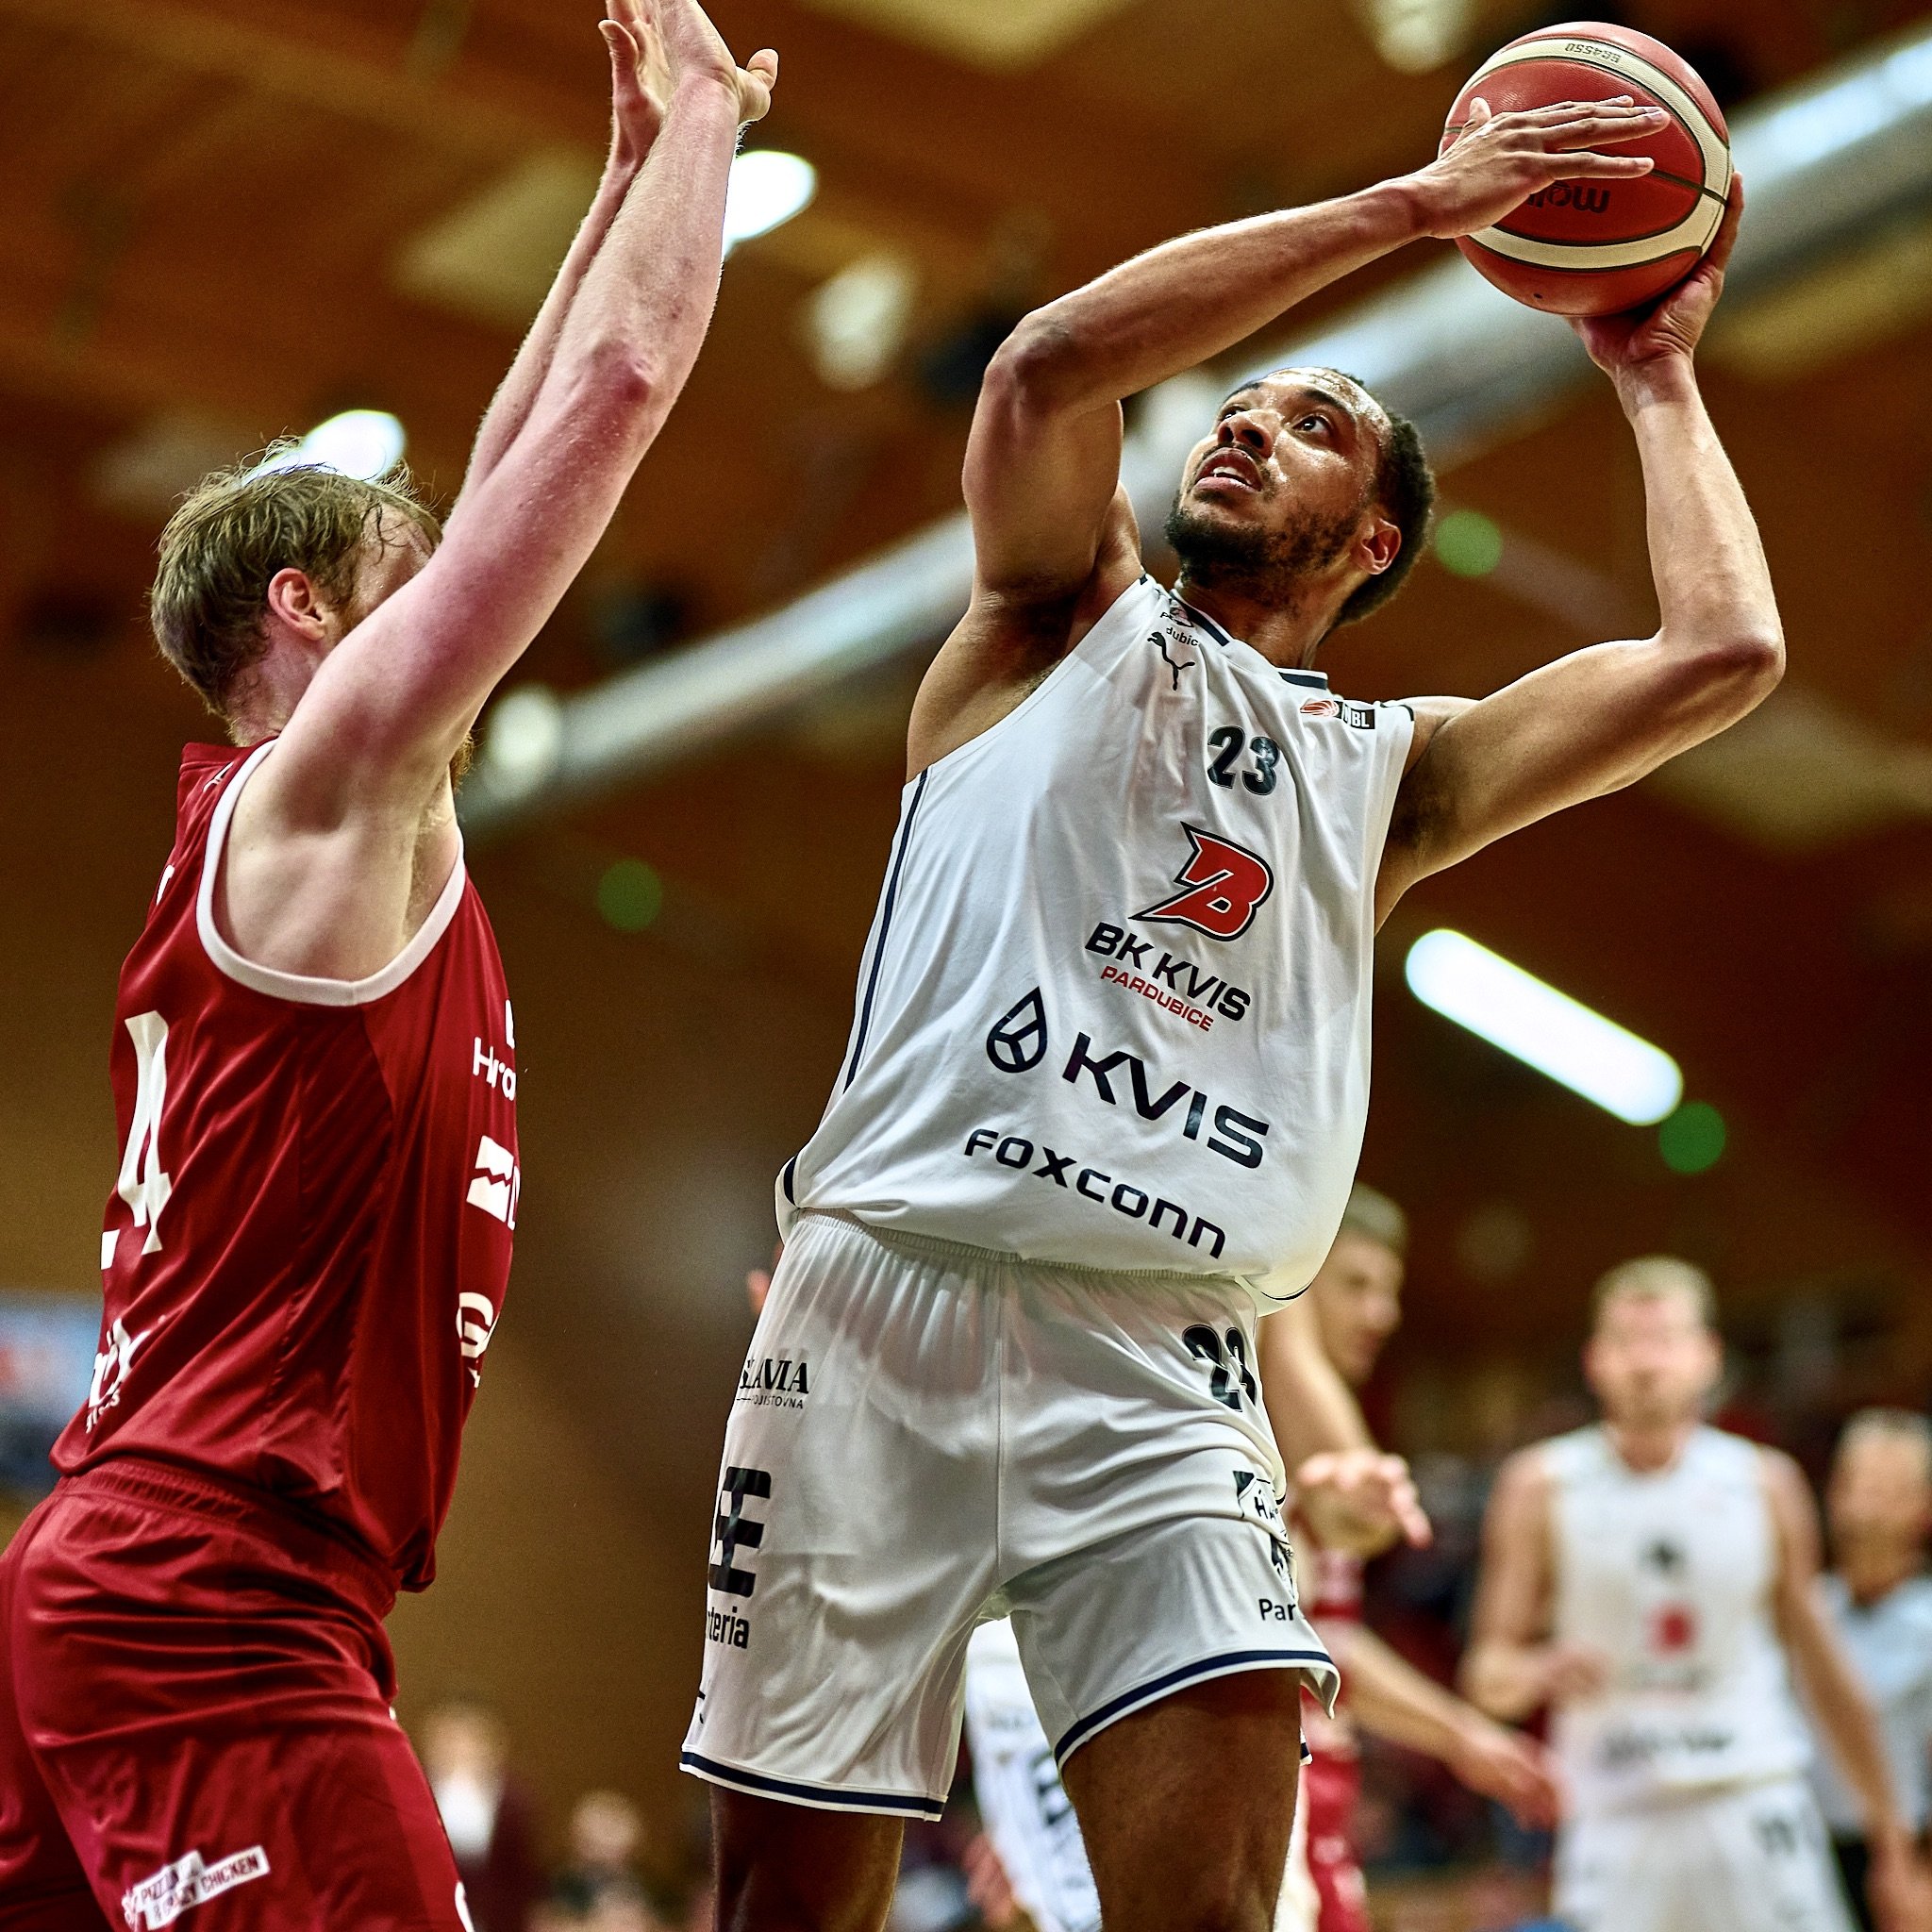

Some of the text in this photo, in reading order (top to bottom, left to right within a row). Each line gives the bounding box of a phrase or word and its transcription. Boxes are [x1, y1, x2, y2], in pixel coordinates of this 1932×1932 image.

[1526, 179, 1611, 214] mol
[1207, 725, 1280, 795] 23
[1085, 922, 1251, 1022] BK KVIS
[1100, 965, 1214, 1032] PARDUBICE
[1062, 1032, 1270, 1170] KVIS
[1258, 1598, 1296, 1621] Par
